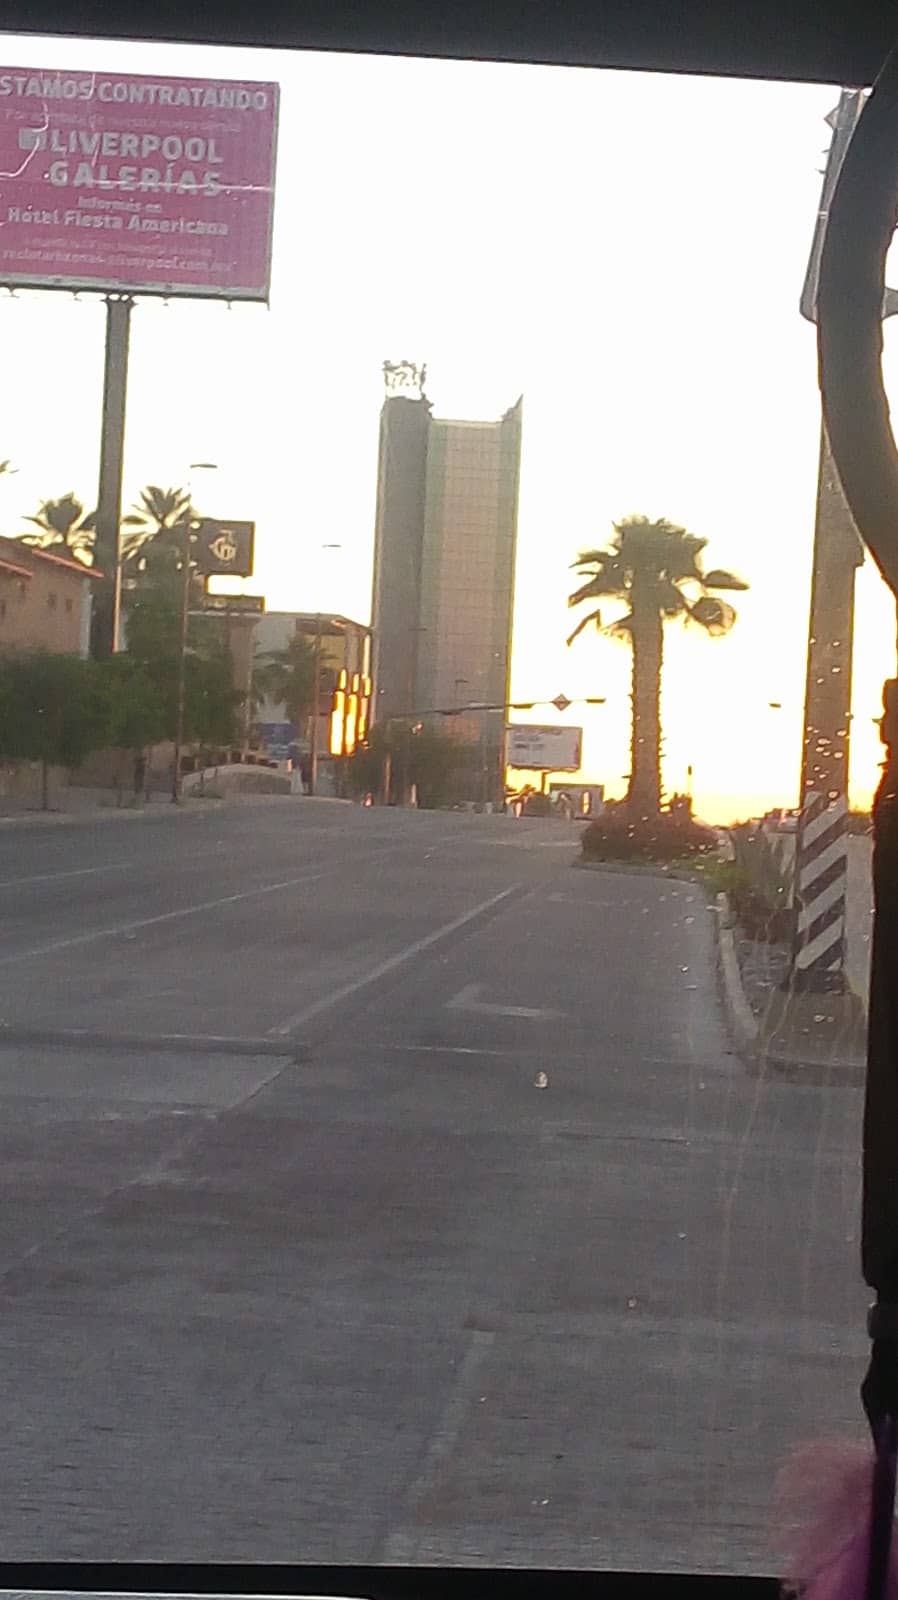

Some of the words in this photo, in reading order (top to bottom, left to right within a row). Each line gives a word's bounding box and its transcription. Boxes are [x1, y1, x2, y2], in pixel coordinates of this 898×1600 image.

[99, 81, 269, 111] CONTRATANDO
[51, 128, 224, 164] LIVERPOOL
[49, 160, 222, 197] GALERÍAS
[7, 207, 60, 225] Hotel
[63, 210, 123, 230] Fiesta
[127, 214, 229, 236] Americana
